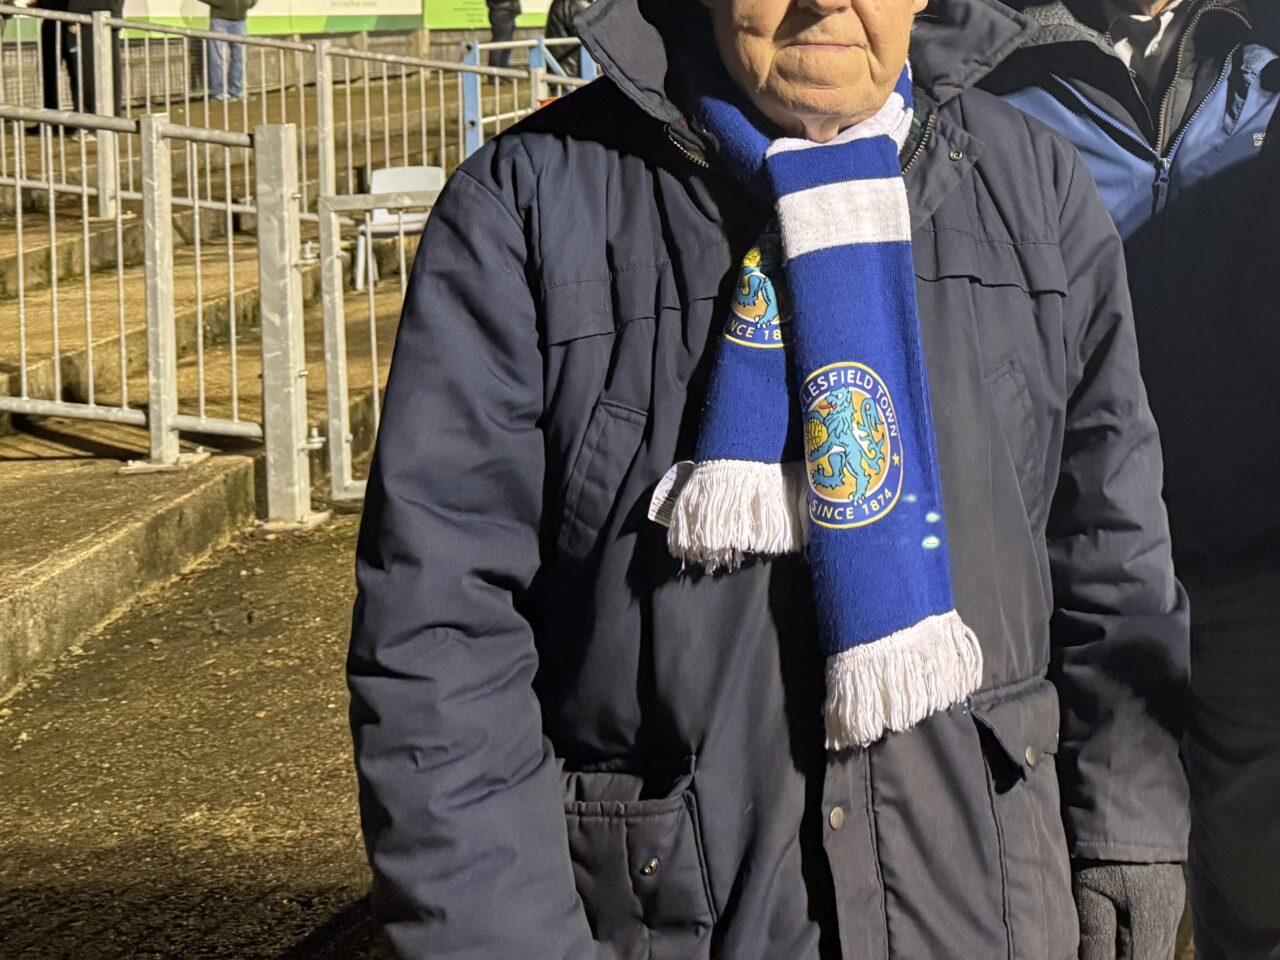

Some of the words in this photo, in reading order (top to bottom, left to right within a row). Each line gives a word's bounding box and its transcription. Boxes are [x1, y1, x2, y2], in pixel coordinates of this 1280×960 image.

[728, 319, 756, 339] NCE
[763, 329, 782, 341] 18
[803, 369, 874, 411] LESFIELD
[876, 384, 898, 438] TOWN
[811, 499, 855, 521] SINCE
[862, 487, 893, 516] 1874
